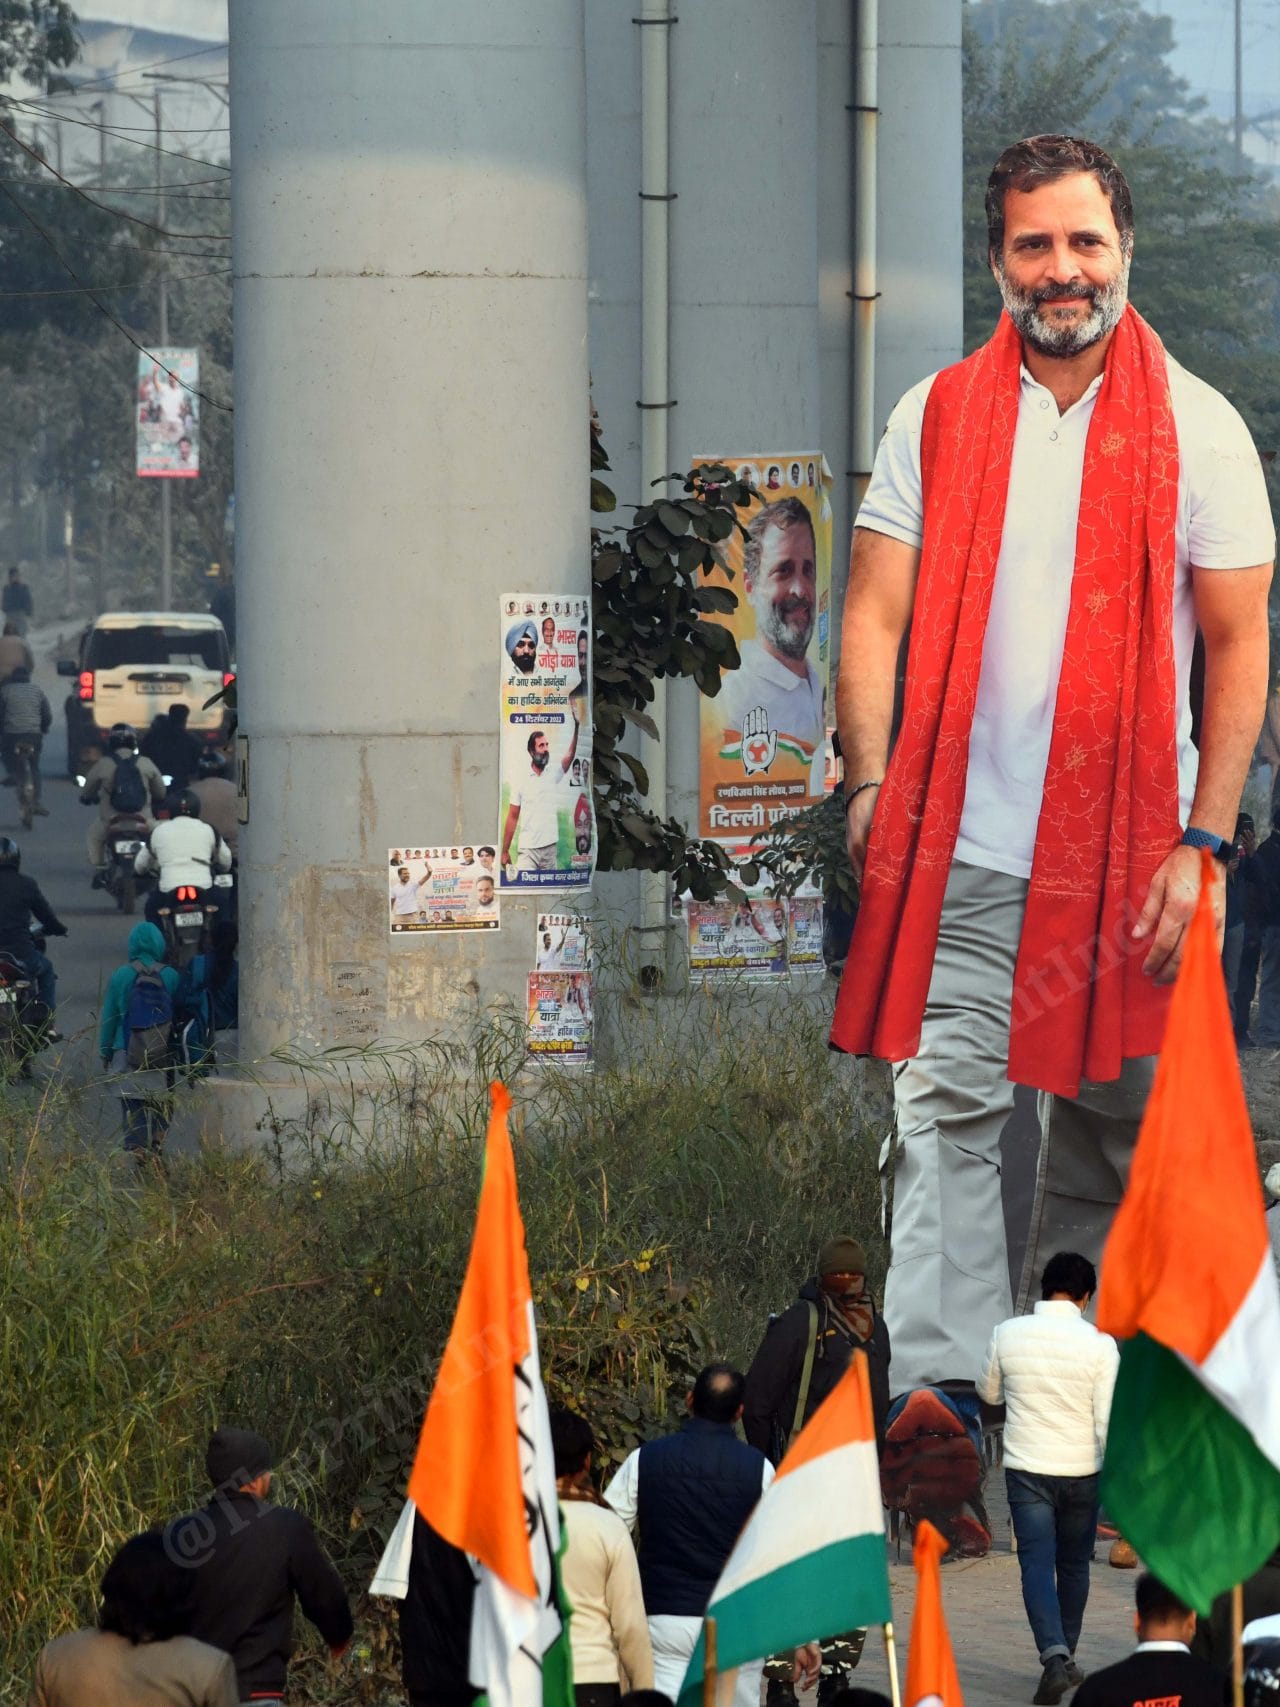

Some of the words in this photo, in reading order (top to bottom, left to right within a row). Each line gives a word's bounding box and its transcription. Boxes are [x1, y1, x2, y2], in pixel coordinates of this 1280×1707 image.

[557, 630, 577, 645] भारत
[561, 654, 576, 668] यात्रा
[709, 803, 766, 828] दिल्ली
